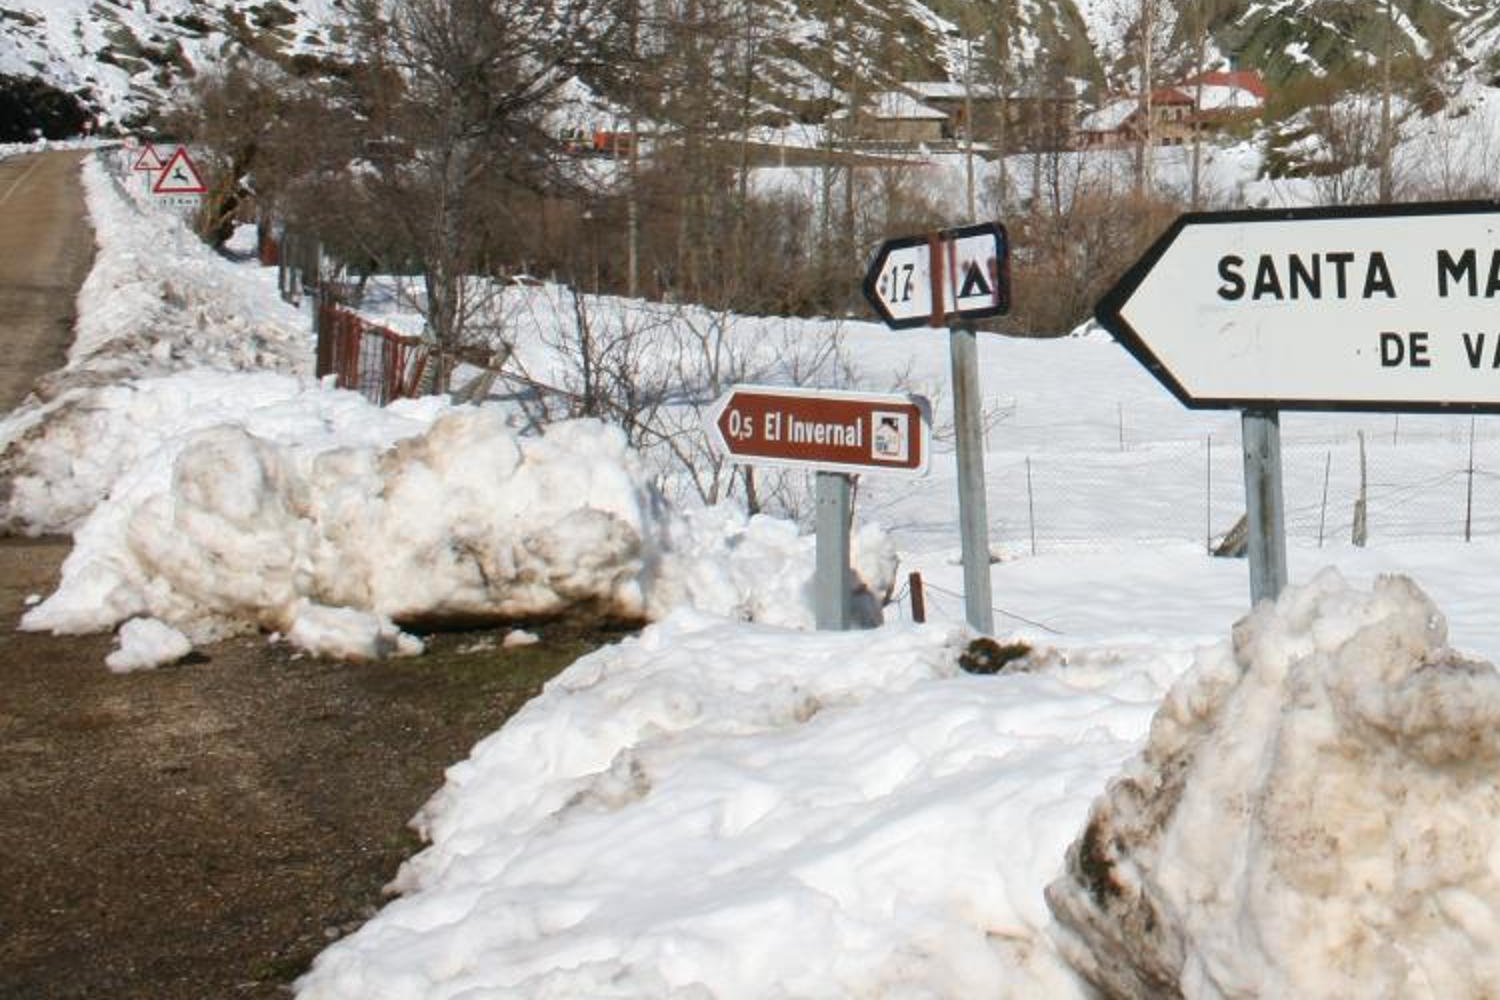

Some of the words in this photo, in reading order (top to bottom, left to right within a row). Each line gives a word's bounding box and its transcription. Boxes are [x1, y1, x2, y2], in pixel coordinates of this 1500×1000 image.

[1217, 250, 1397, 301] SANTA
[1380, 331, 1431, 368] DE
[764, 411, 781, 441] El
[787, 414, 863, 447] Invernal
